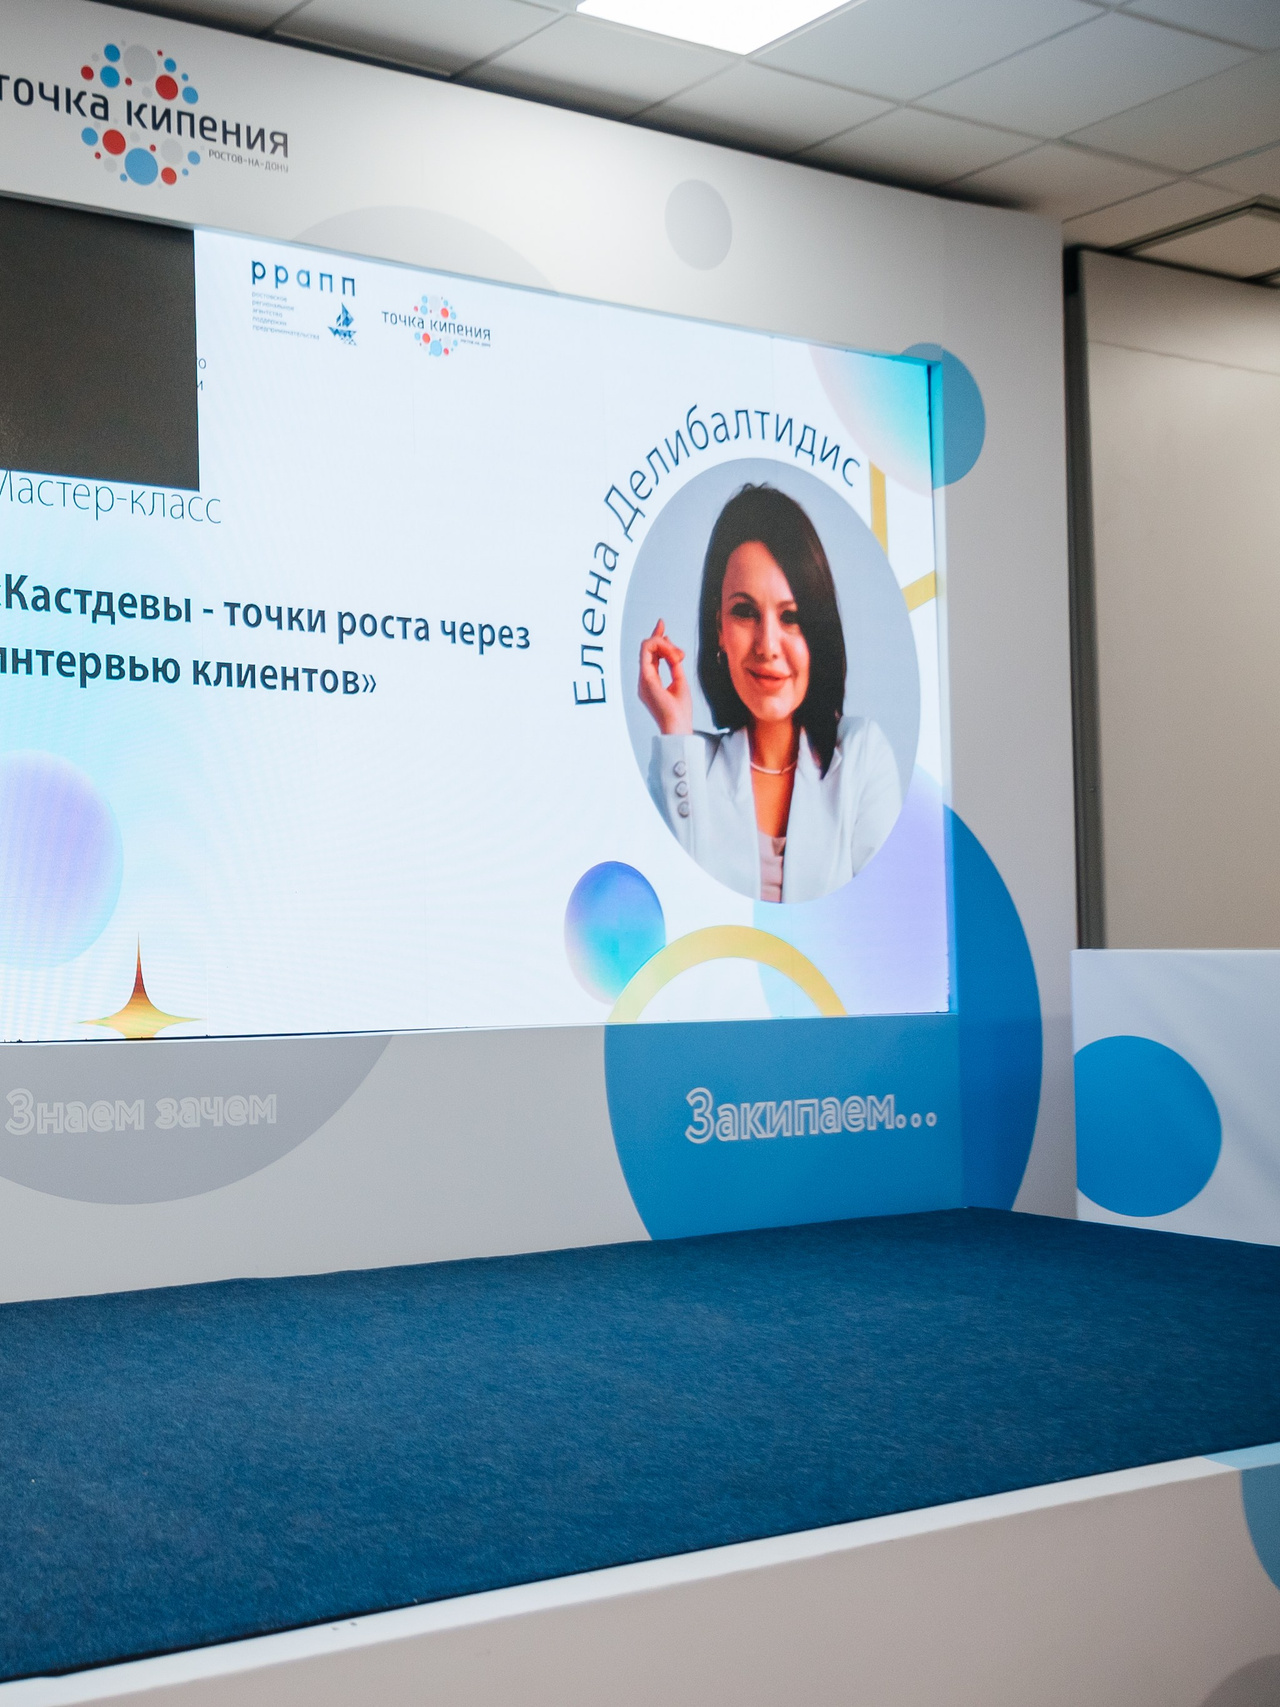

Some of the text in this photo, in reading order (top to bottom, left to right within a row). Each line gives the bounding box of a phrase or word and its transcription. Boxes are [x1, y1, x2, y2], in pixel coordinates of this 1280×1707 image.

[126, 99, 289, 158] кипения
[381, 311, 491, 341] точка кипения
[573, 404, 861, 705] Елена Делибалтидис
[223, 601, 326, 635] точки
[338, 611, 430, 643] роста
[441, 620, 531, 655] через
[192, 659, 377, 695] клиентов»
[5, 1087, 277, 1136] Знаем зачем
[684, 1087, 937, 1144] Закипаем...
